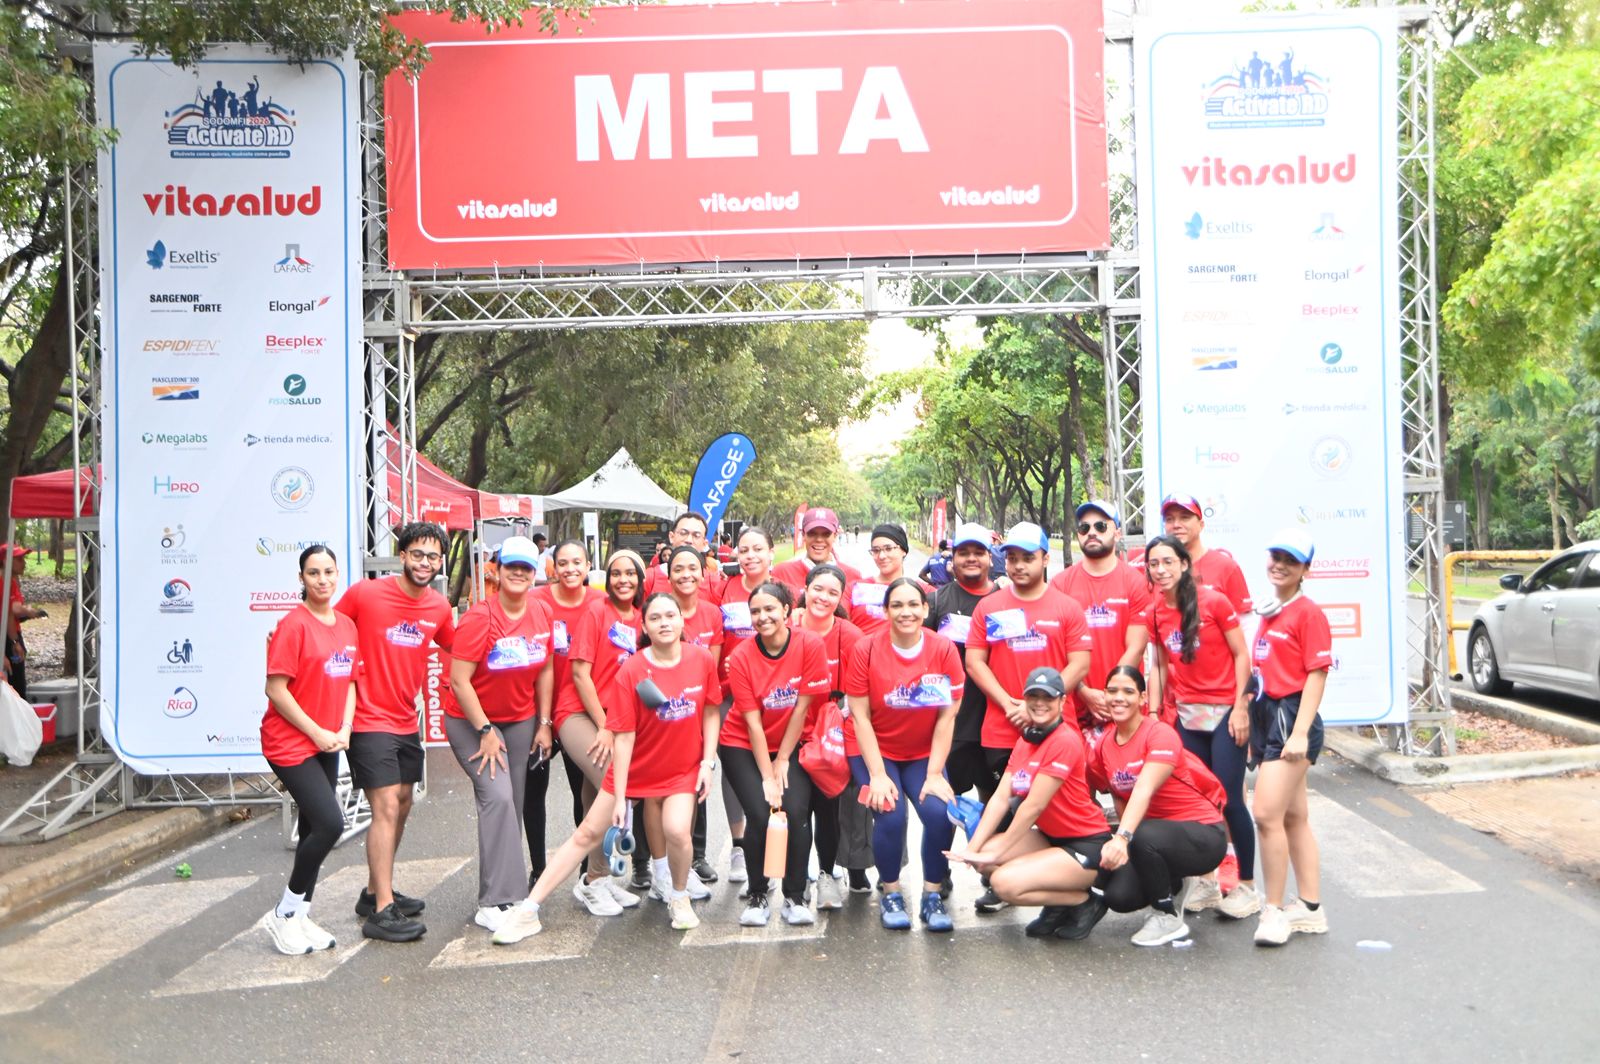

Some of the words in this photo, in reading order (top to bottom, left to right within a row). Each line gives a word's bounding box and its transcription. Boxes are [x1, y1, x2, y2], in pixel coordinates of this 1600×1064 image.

[574, 65, 930, 161] META
[203, 117, 247, 126] SODOMFI
[248, 116, 270, 126] 2026
[266, 126, 292, 146] RD
[1181, 154, 1356, 186] vitasalud
[143, 184, 321, 216] vitasalud
[699, 190, 799, 213] vitasalud
[939, 184, 1040, 207] vitasalud
[457, 198, 557, 220] vitasalud
[169, 250, 218, 264] Exeltis
[273, 263, 312, 273] LAFAGE
[1187, 264, 1237, 274] SARGENOR
[1230, 273, 1258, 283] FORTE
[1304, 268, 1350, 283] Elongal
[149, 294, 200, 303] SARGENOR
[193, 303, 222, 312] FORTE
[269, 300, 314, 314] Elongal
[1302, 304, 1359, 317] Beeplex
[143, 339, 218, 352] ESPIDIFEN
[266, 335, 323, 349] Beeplex
[156, 433, 208, 446] Megalabs
[264, 435, 294, 444] tienda
[154, 475, 200, 495] HPRO
[1313, 559, 1369, 569] DOACTIVE
[250, 592, 303, 601] TENDOAC
[502, 639, 520, 648] 012
[924, 676, 944, 685] 007
[427, 652, 445, 739] vitasalud
[167, 699, 193, 711] Rica
